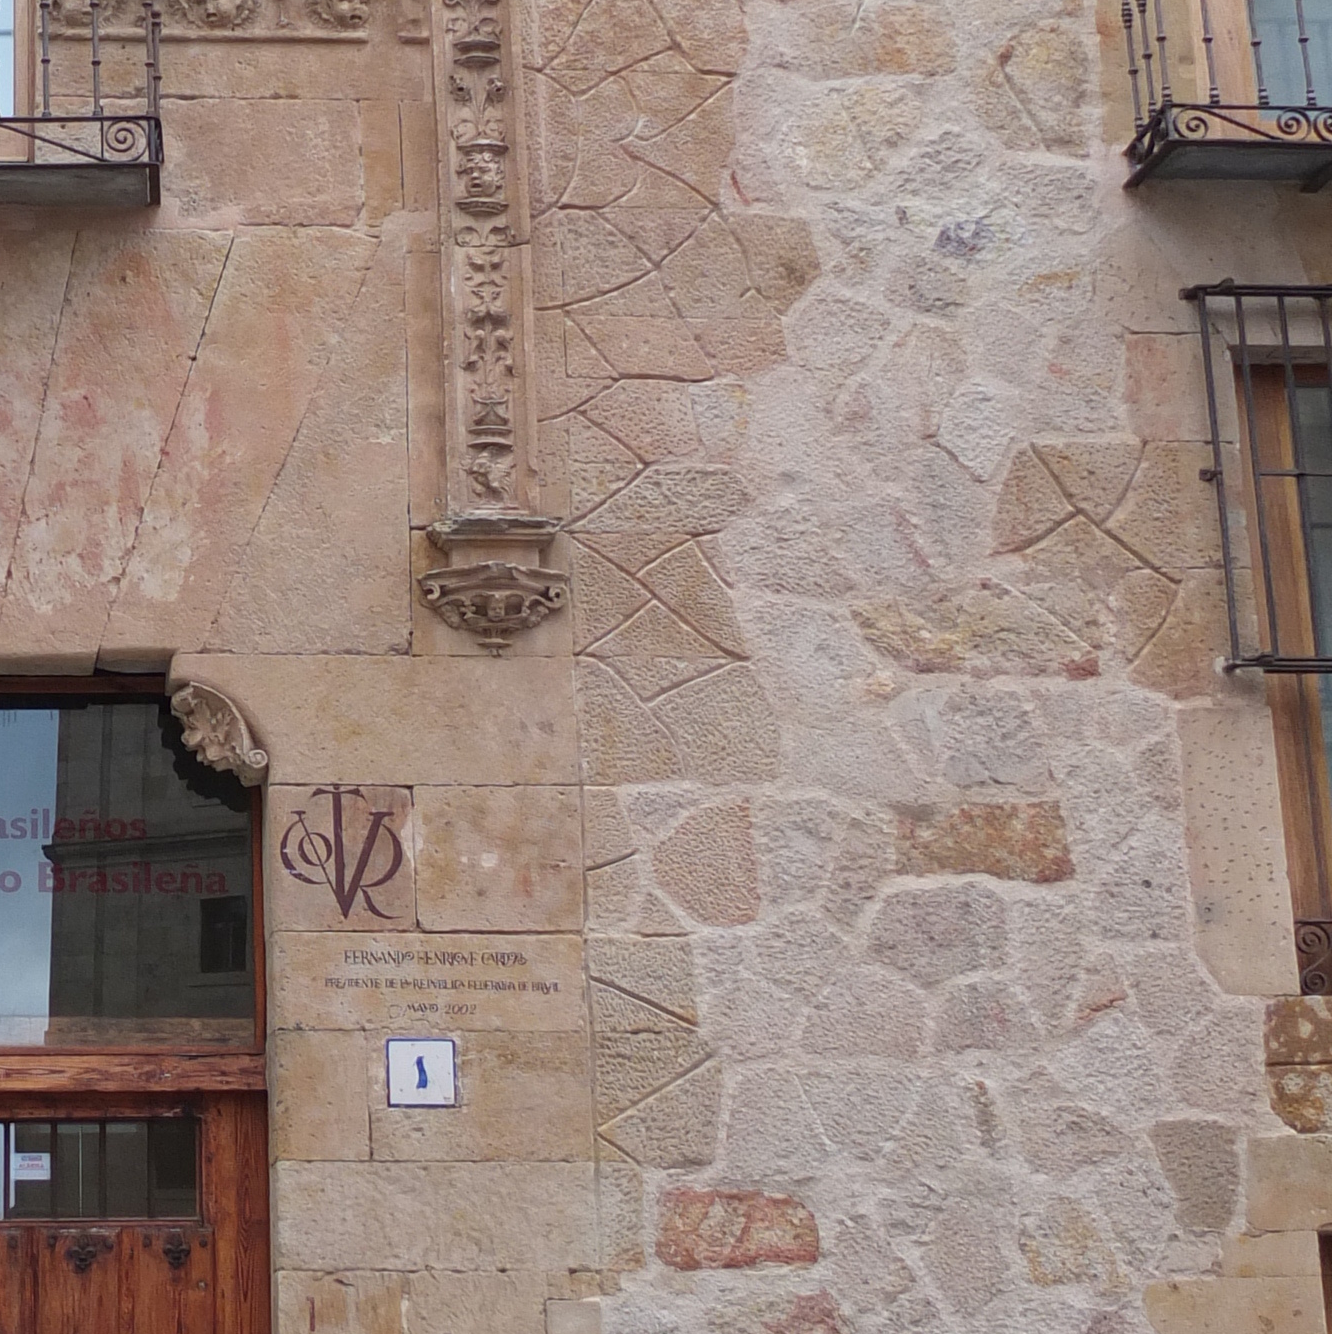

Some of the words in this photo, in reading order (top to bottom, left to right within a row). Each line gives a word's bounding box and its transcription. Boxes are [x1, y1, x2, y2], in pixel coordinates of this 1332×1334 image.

[37, 861, 229, 895] Brasileña
[343, 949, 415, 966] FERNANDO
[444, 1003, 477, 1015] 2002
[415, 1055, 428, 1089] 1
